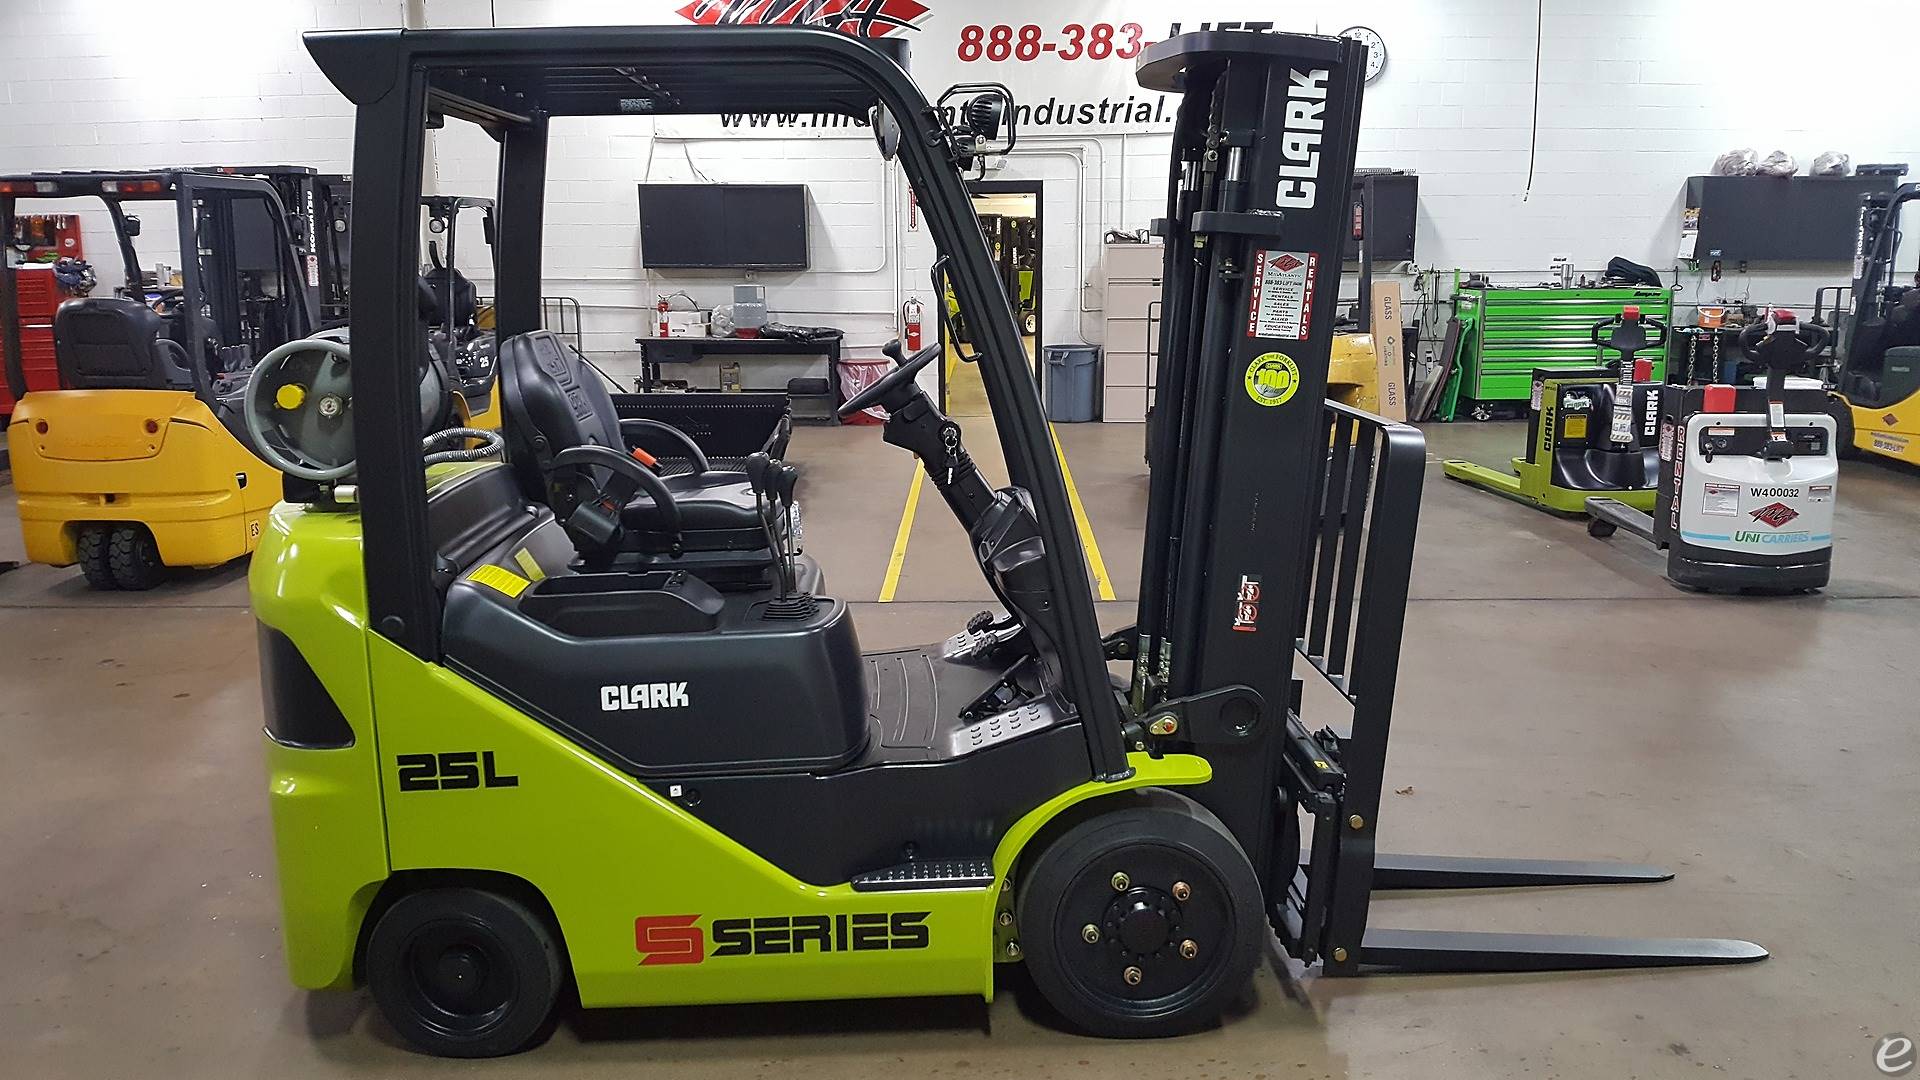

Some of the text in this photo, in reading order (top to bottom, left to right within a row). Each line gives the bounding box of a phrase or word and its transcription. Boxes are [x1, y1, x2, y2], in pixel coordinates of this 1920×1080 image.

[1275, 68, 1330, 209] CLARK
[1249, 253, 1264, 332] SERVICE
[1301, 257, 1316, 336] RENTALS
[1384, 296, 1392, 320] GLASS
[1256, 368, 1290, 389] 100
[1388, 382, 1396, 406] GLASS
[1543, 406, 1554, 452] CLARK
[1644, 389, 1659, 436] CLARK
[1671, 425, 1685, 530] RENTAL
[1750, 488, 1799, 498] W400032
[600, 682, 689, 711] CLARK
[396, 751, 519, 792] 25L
[710, 911, 932, 957] SERIES
